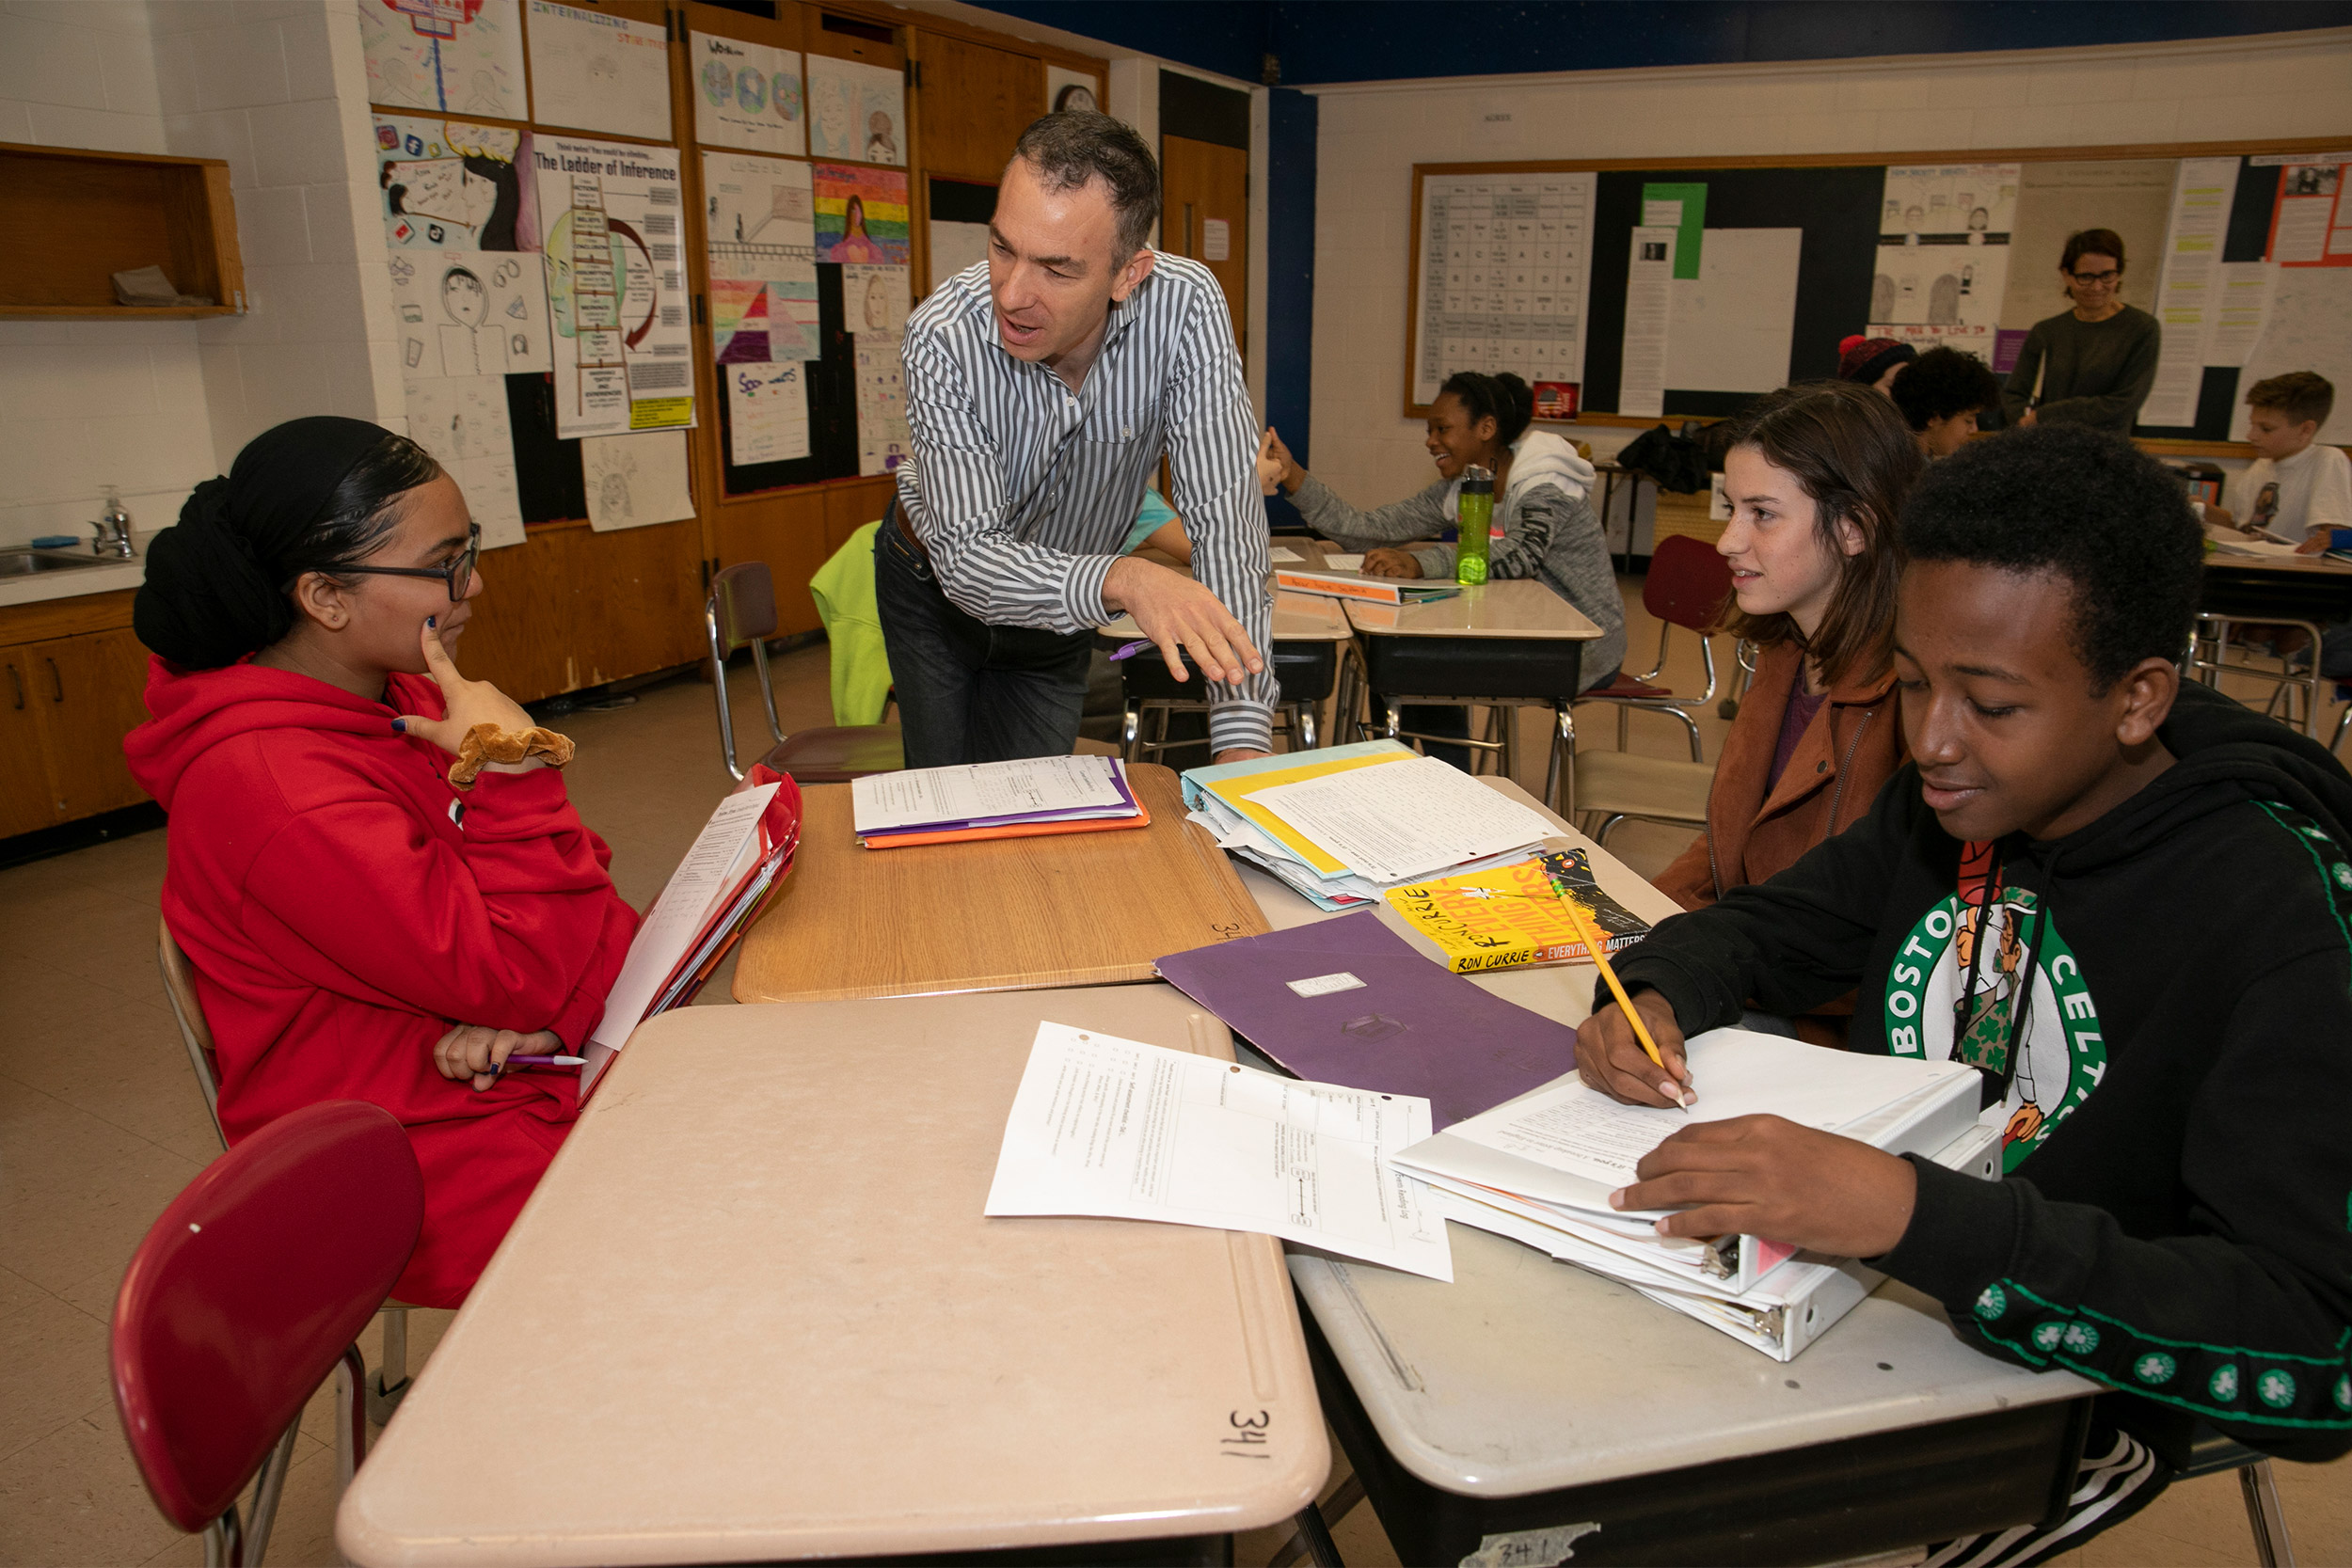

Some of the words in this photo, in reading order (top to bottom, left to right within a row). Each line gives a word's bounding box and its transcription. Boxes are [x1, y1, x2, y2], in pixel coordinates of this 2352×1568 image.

[534, 151, 558, 171] The
[560, 154, 603, 175] Ladder
[606, 160, 618, 177] of
[620, 161, 676, 182] Inference
[1404, 889, 1469, 931] CURRIE
[1492, 902, 1573, 946] THING
[1452, 929, 1511, 948] RON
[1457, 955, 1482, 973] RON
[1486, 950, 1530, 968] CURRIE
[1548, 941, 1603, 959] EVERYTHG
[1888, 896, 1959, 1054] BOSTO
[1393, 1172, 1406, 1190] Events
[1395, 1188, 1408, 1210] Reading
[1398, 1208, 1410, 1220] Log
[1220, 1410, 1271, 1459] 341
[1498, 1538, 1549, 1564] 341
